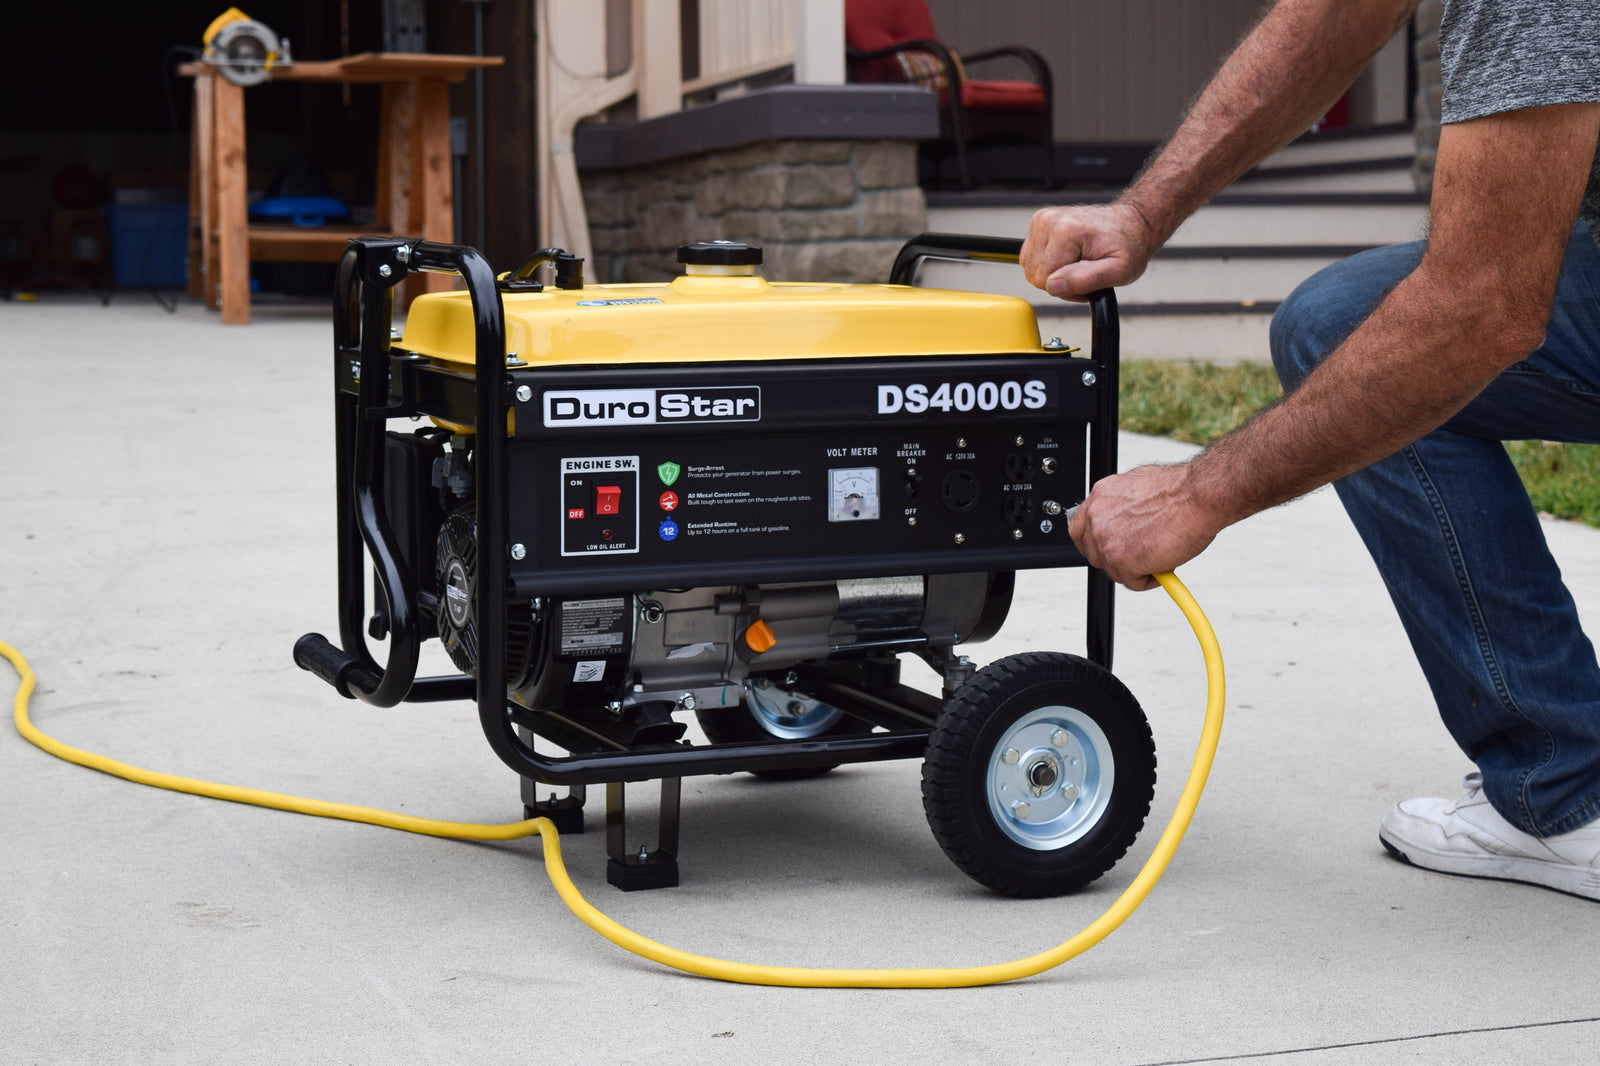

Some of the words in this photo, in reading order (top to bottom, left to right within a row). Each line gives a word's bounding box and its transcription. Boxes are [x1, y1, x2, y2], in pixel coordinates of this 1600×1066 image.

[878, 380, 1047, 414] DS4000S
[827, 448, 847, 457] VOLT
[851, 447, 878, 456] METER
[566, 460, 611, 470] ENGINE
[615, 460, 635, 468] SW.
[663, 527, 674, 536] 12
